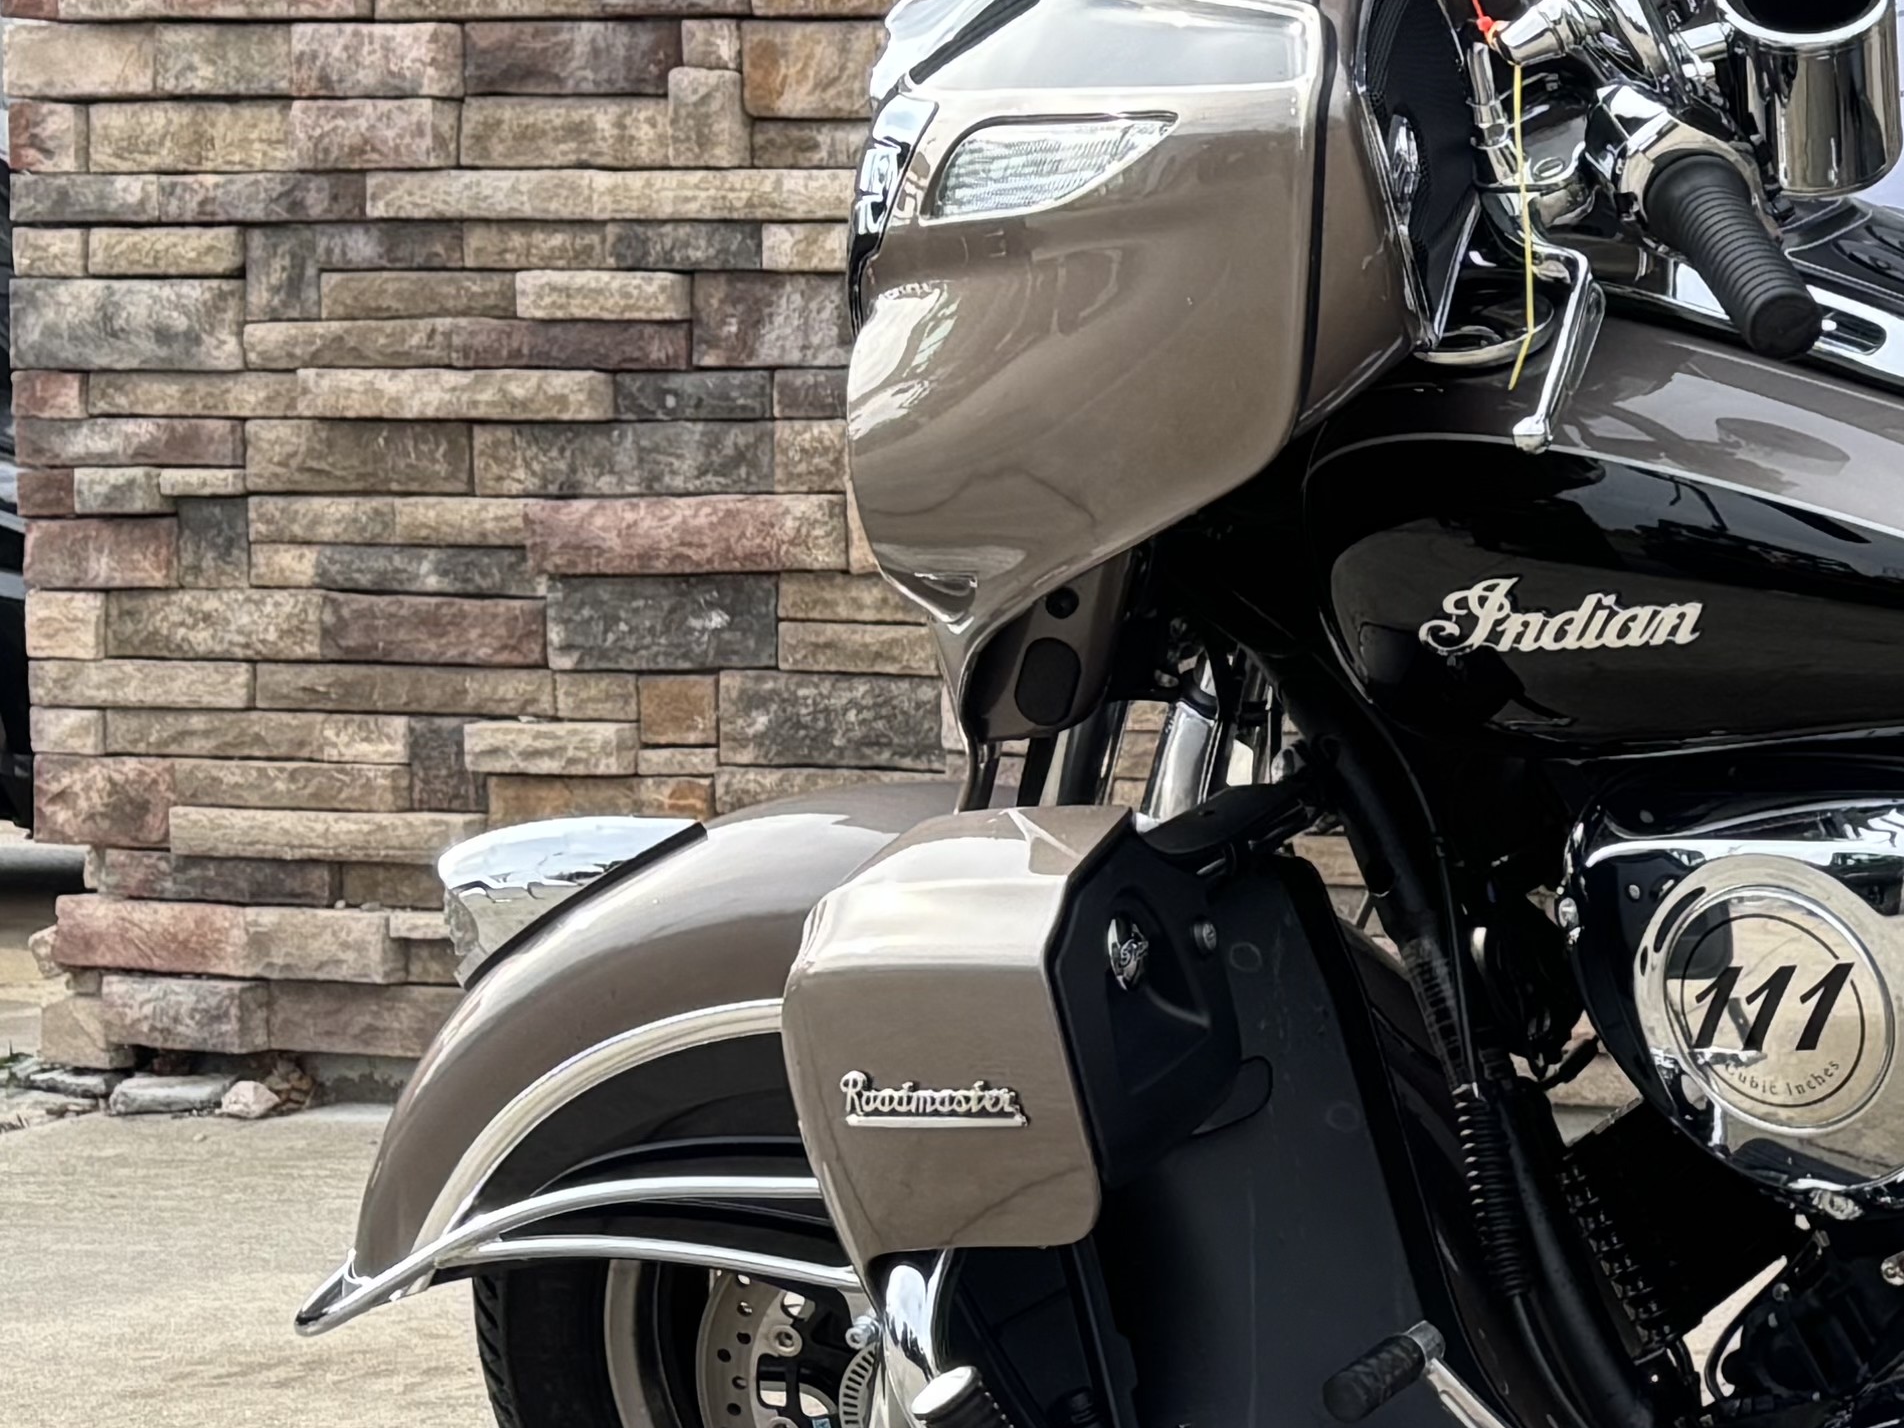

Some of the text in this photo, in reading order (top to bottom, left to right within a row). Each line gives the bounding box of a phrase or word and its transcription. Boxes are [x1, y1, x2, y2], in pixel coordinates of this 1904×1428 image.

[1418, 576, 1704, 652] Indian
[1693, 961, 1856, 1051] 111
[839, 1070, 1022, 1118] Roadmaster
[1725, 1061, 1839, 1096] Cubic Inches
